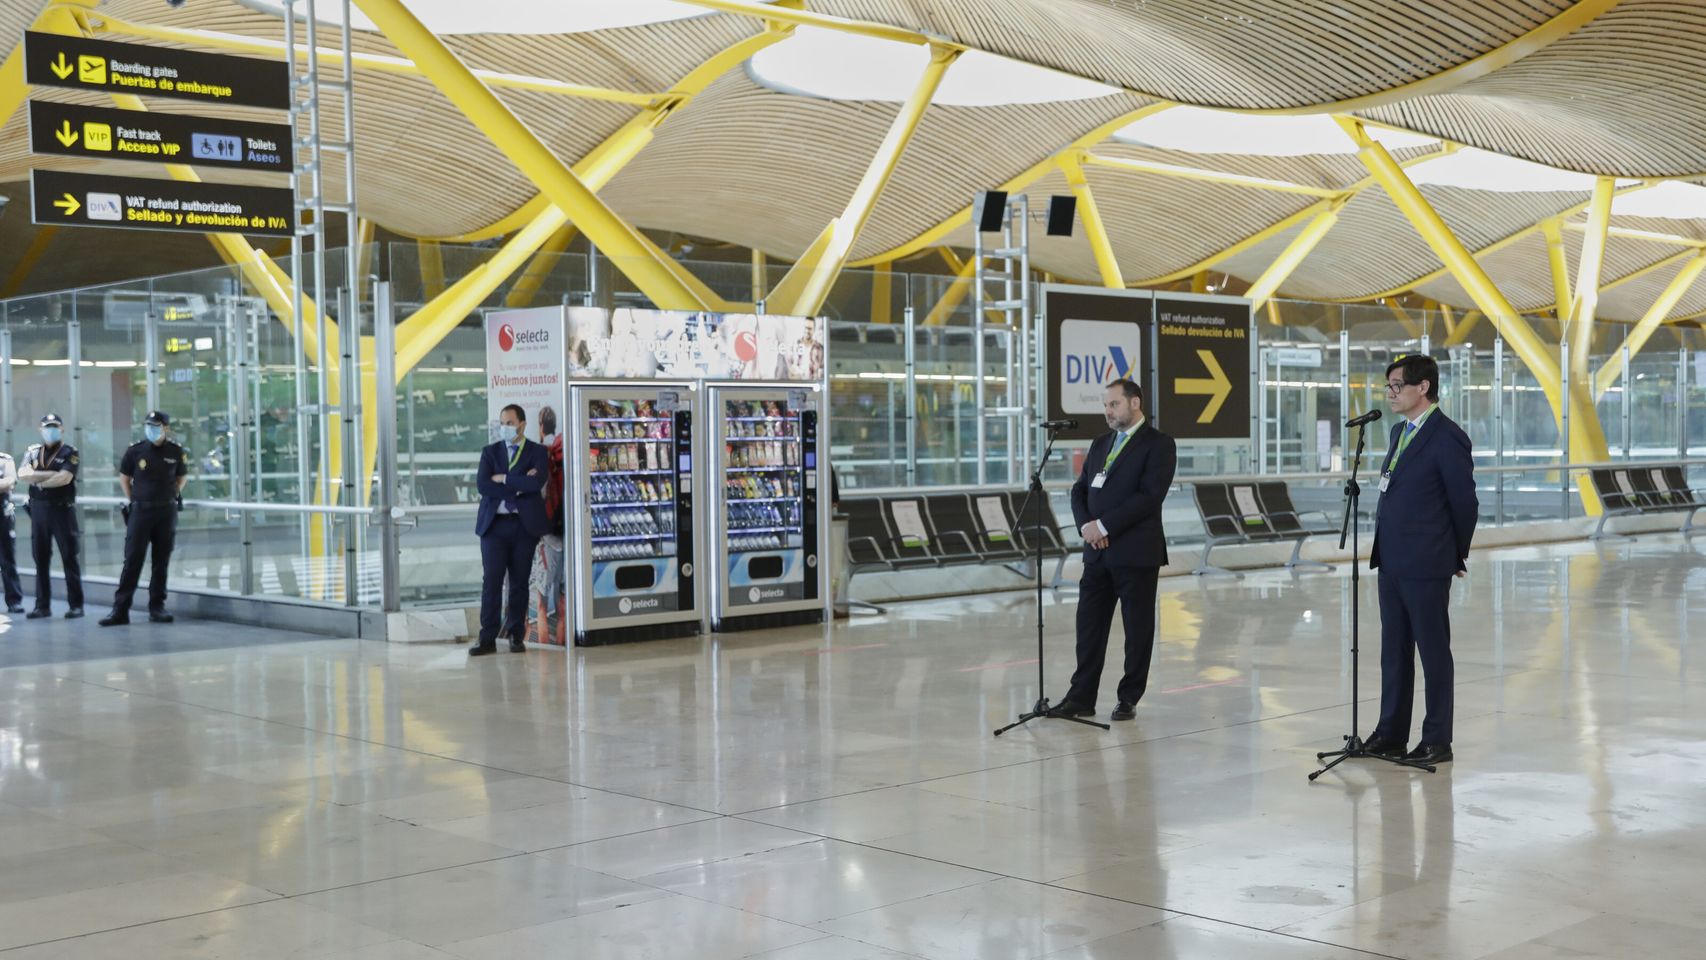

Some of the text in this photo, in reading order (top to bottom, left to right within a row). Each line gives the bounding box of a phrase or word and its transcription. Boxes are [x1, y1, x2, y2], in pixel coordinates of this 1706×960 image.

[110, 59, 178, 78] Boarding gates
[111, 72, 232, 98] Puertas de embarque
[88, 131, 108, 142] VIP
[116, 126, 162, 141] Fast track
[117, 140, 181, 156] Acceso VIP
[246, 137, 277, 151] Toilets
[248, 150, 281, 164] Aseos
[126, 195, 242, 214] VAT refund authorization
[127, 208, 288, 229] Sellado y devolución de IVA
[1160, 312, 1226, 325] VAT refund authorization
[516, 328, 549, 344] selecta
[1161, 324, 1245, 339] Sellado devolución de IVA
[491, 371, 559, 390] ¡Volemos juntos!
[760, 587, 784, 598] selecta
[632, 598, 659, 609] selecta
